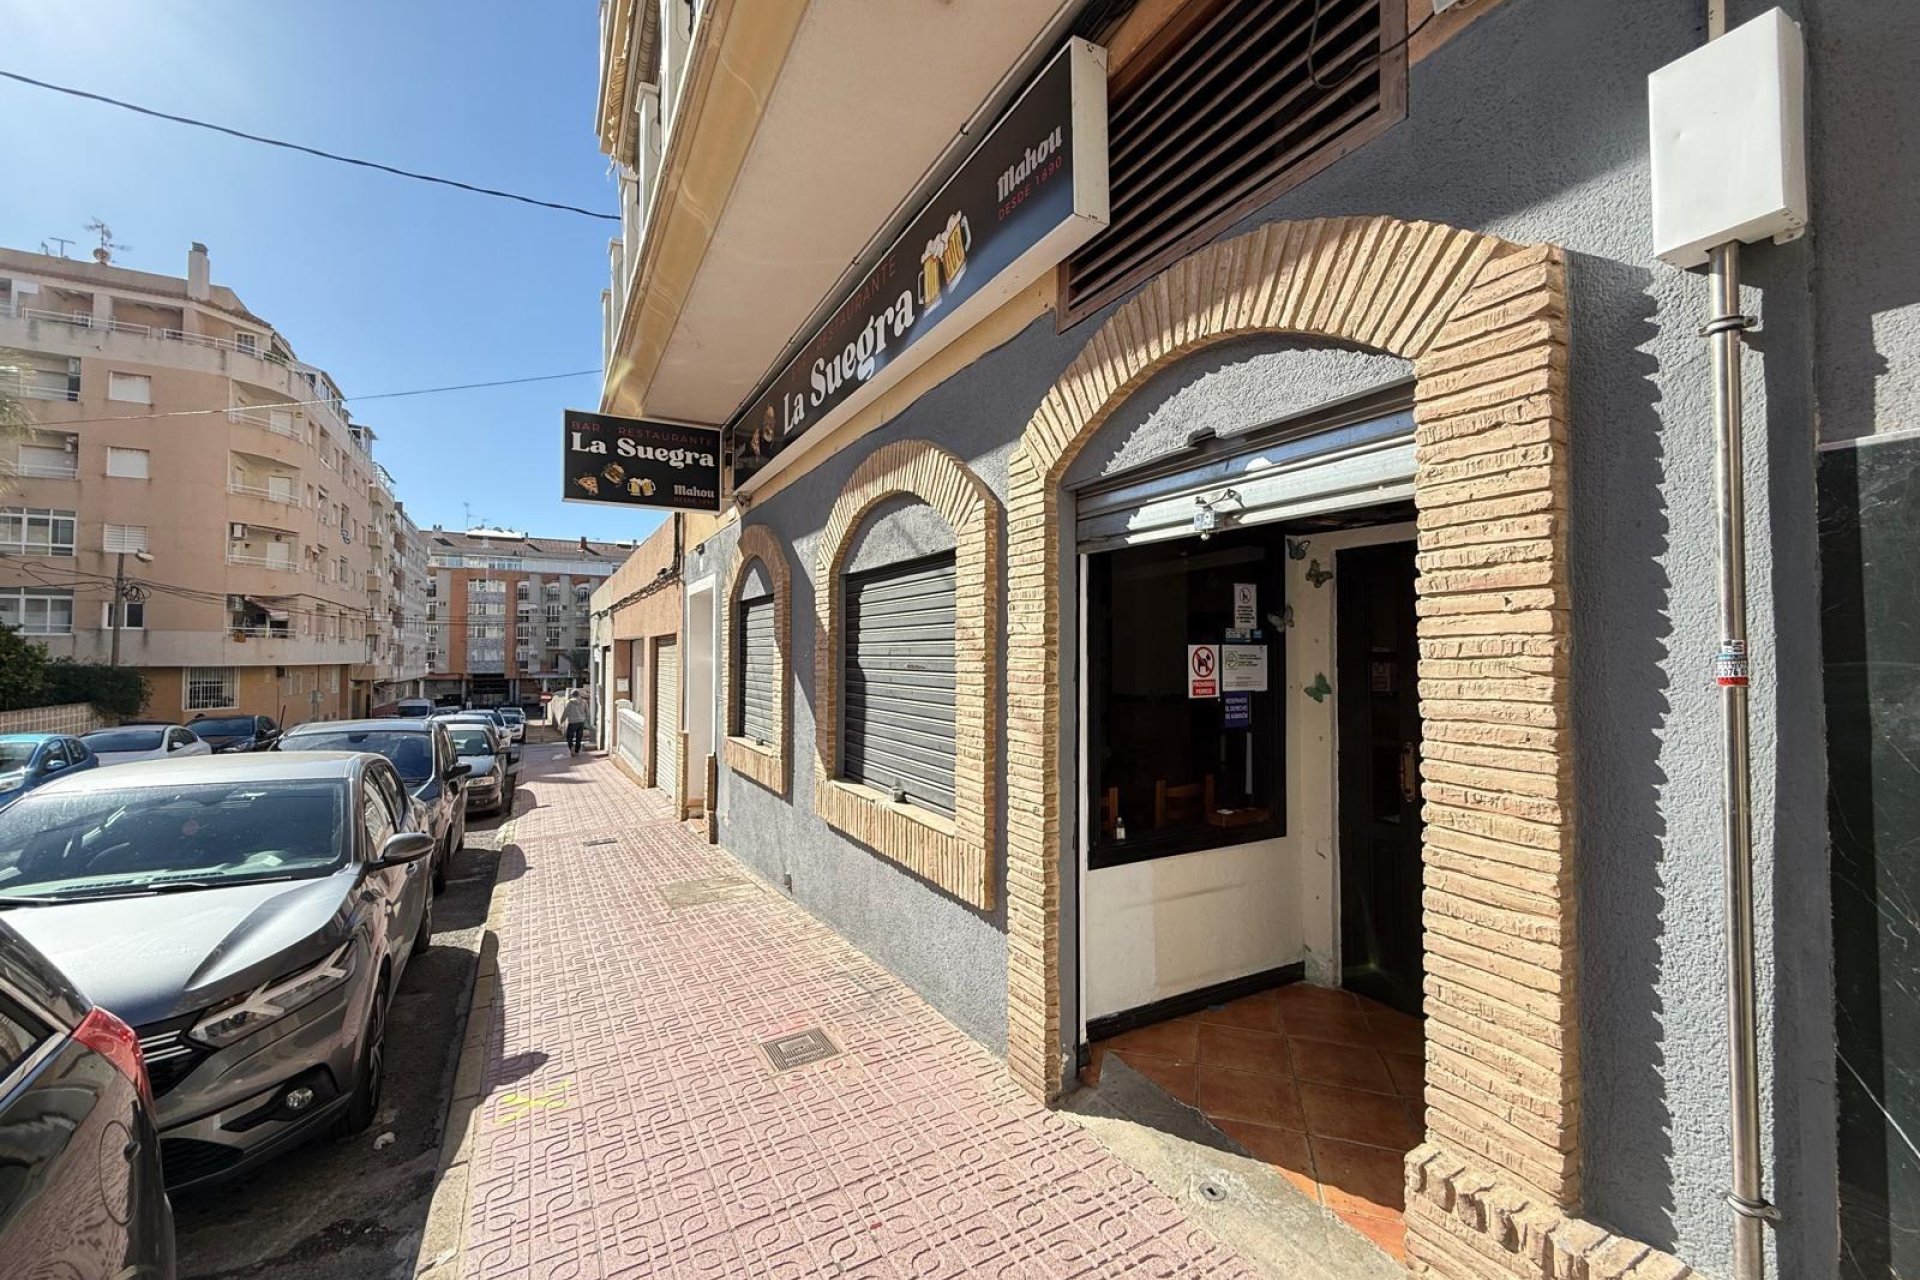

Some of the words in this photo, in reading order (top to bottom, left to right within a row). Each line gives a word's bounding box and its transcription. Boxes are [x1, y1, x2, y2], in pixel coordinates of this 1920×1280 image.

[996, 126, 1063, 202] Mahou
[998, 187, 1031, 221] DESDE
[1035, 155, 1062, 186] 1890
[783, 392, 805, 435] La
[810, 289, 915, 407] Suegra
[571, 420, 601, 432] BAR
[618, 426, 712, 446] RESTAURANTE
[571, 431, 608, 455] La
[616, 437, 715, 469] Suegra
[673, 484, 715, 498] Mahou
